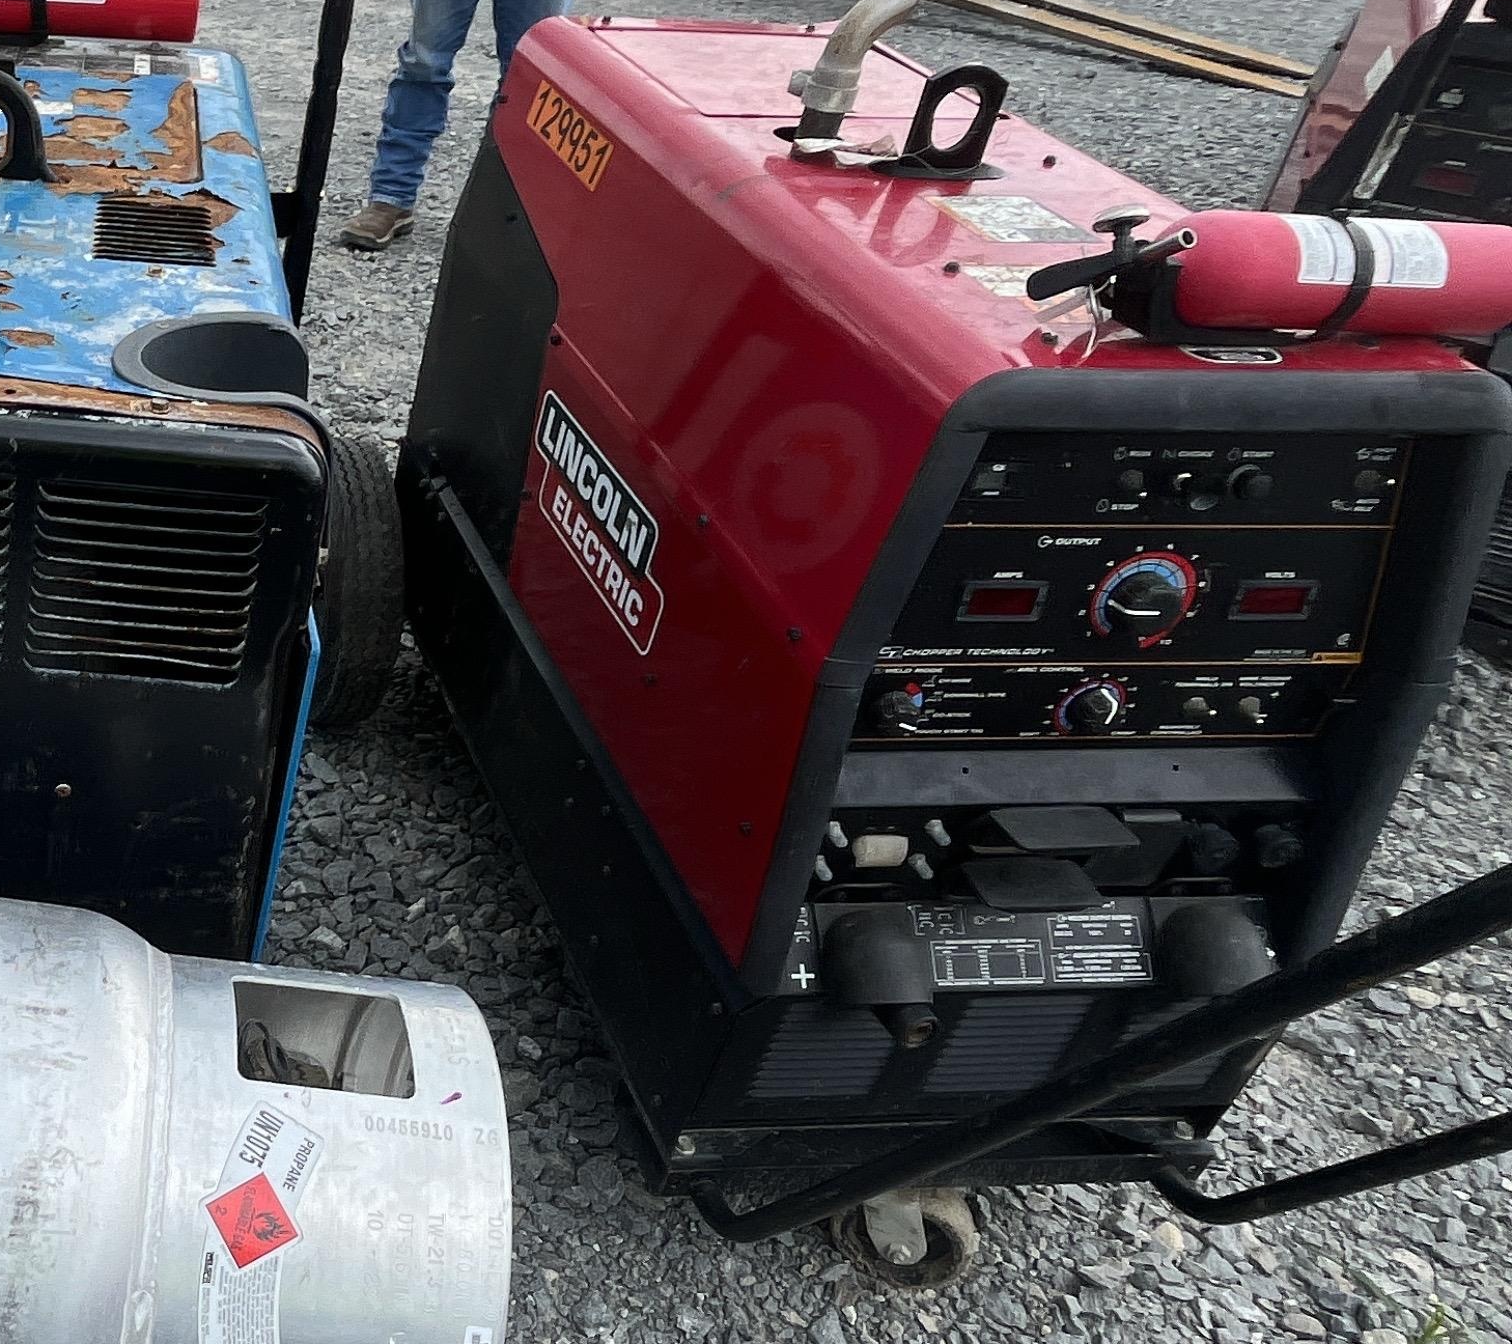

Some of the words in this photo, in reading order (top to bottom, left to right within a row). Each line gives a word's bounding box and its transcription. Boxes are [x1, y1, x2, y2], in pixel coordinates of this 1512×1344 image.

[532, 86, 610, 185] 129951
[542, 406, 648, 568] LINCOLN
[551, 484, 644, 627] ELECTRIC
[1054, 537, 1103, 546] OUTPUT
[902, 647, 963, 656] CHOPPER
[238, 1109, 284, 1169] UN1075
[282, 1136, 316, 1192] PROPANE
